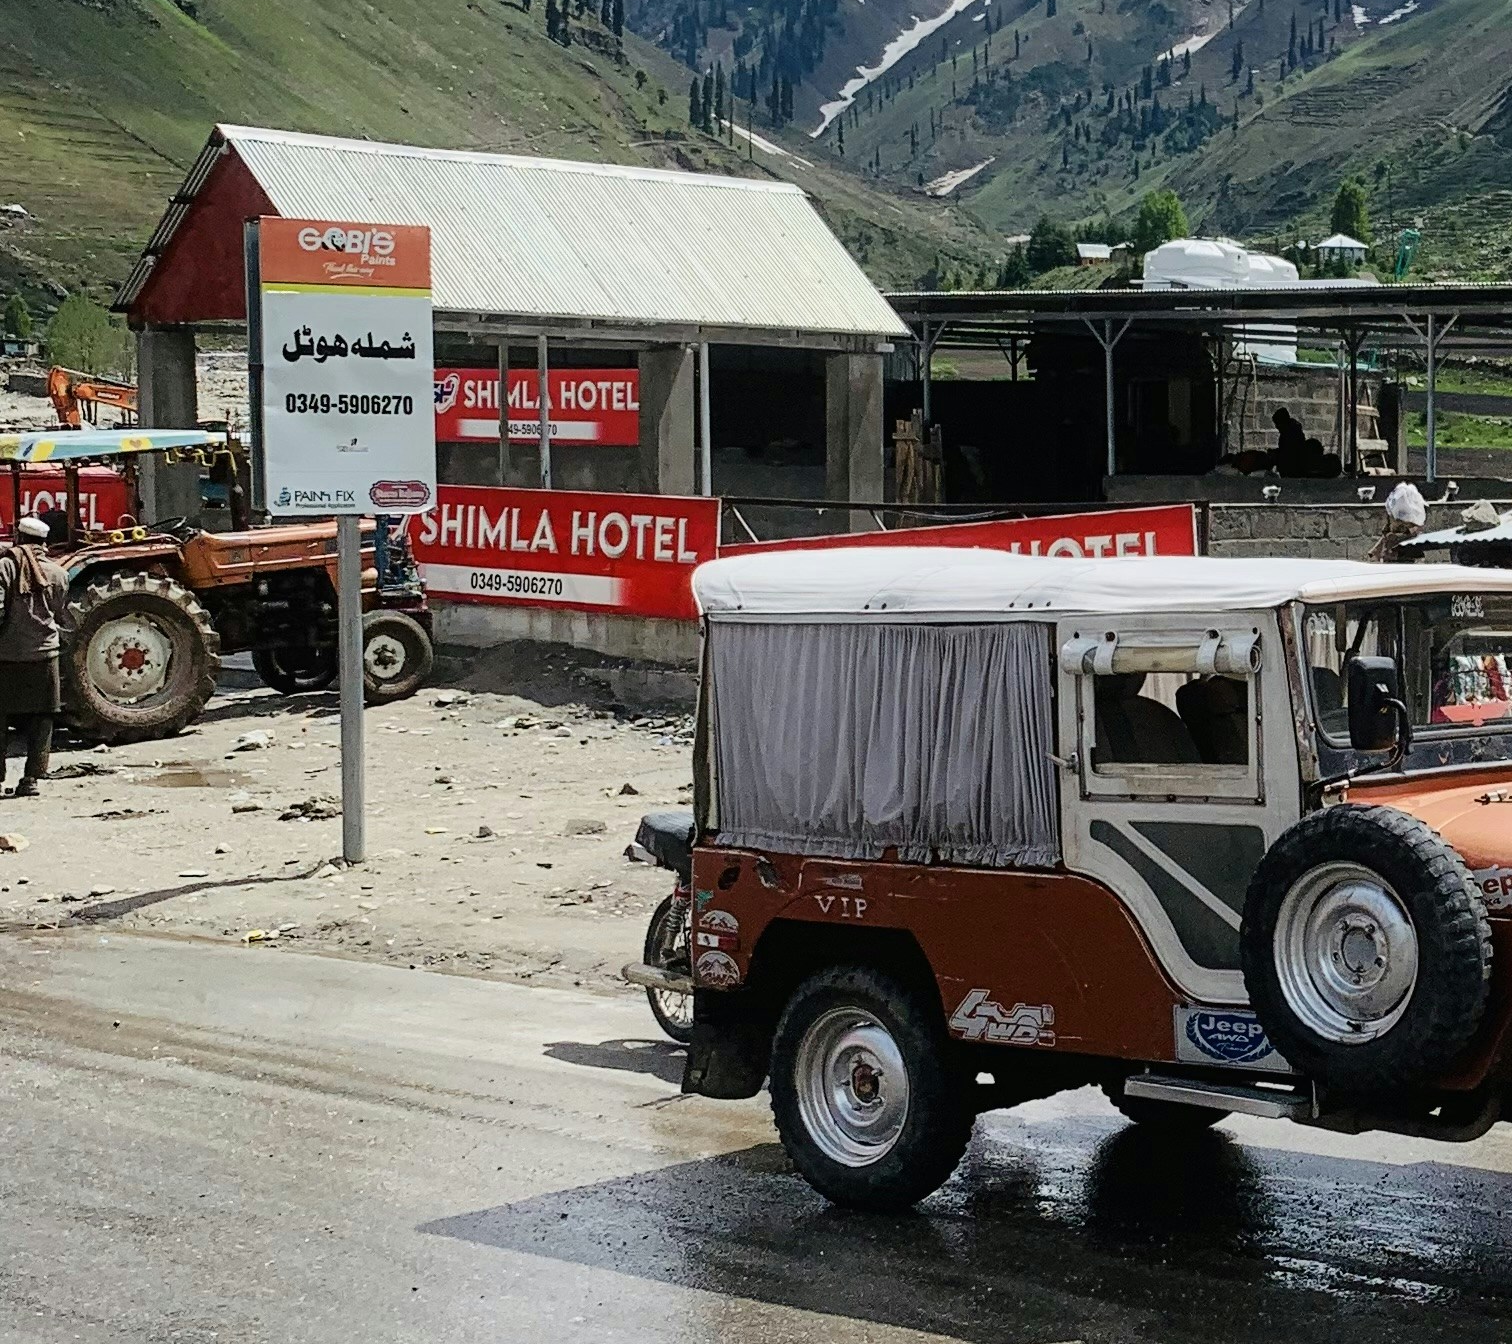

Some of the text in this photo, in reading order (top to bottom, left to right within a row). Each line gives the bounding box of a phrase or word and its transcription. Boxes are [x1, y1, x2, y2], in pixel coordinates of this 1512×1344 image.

[360, 254, 396, 267] Paints
[285, 392, 414, 416] 0349-5906270
[560, 380, 641, 411] HOTEL
[336, 490, 355, 502] FIX
[419, 503, 698, 564] SHIMLA HOTEL
[469, 571, 563, 596] 0349-5906270
[814, 895, 868, 919] VIP
[950, 988, 1045, 1045] 4WD
[1201, 1016, 1263, 1038] Jeep
